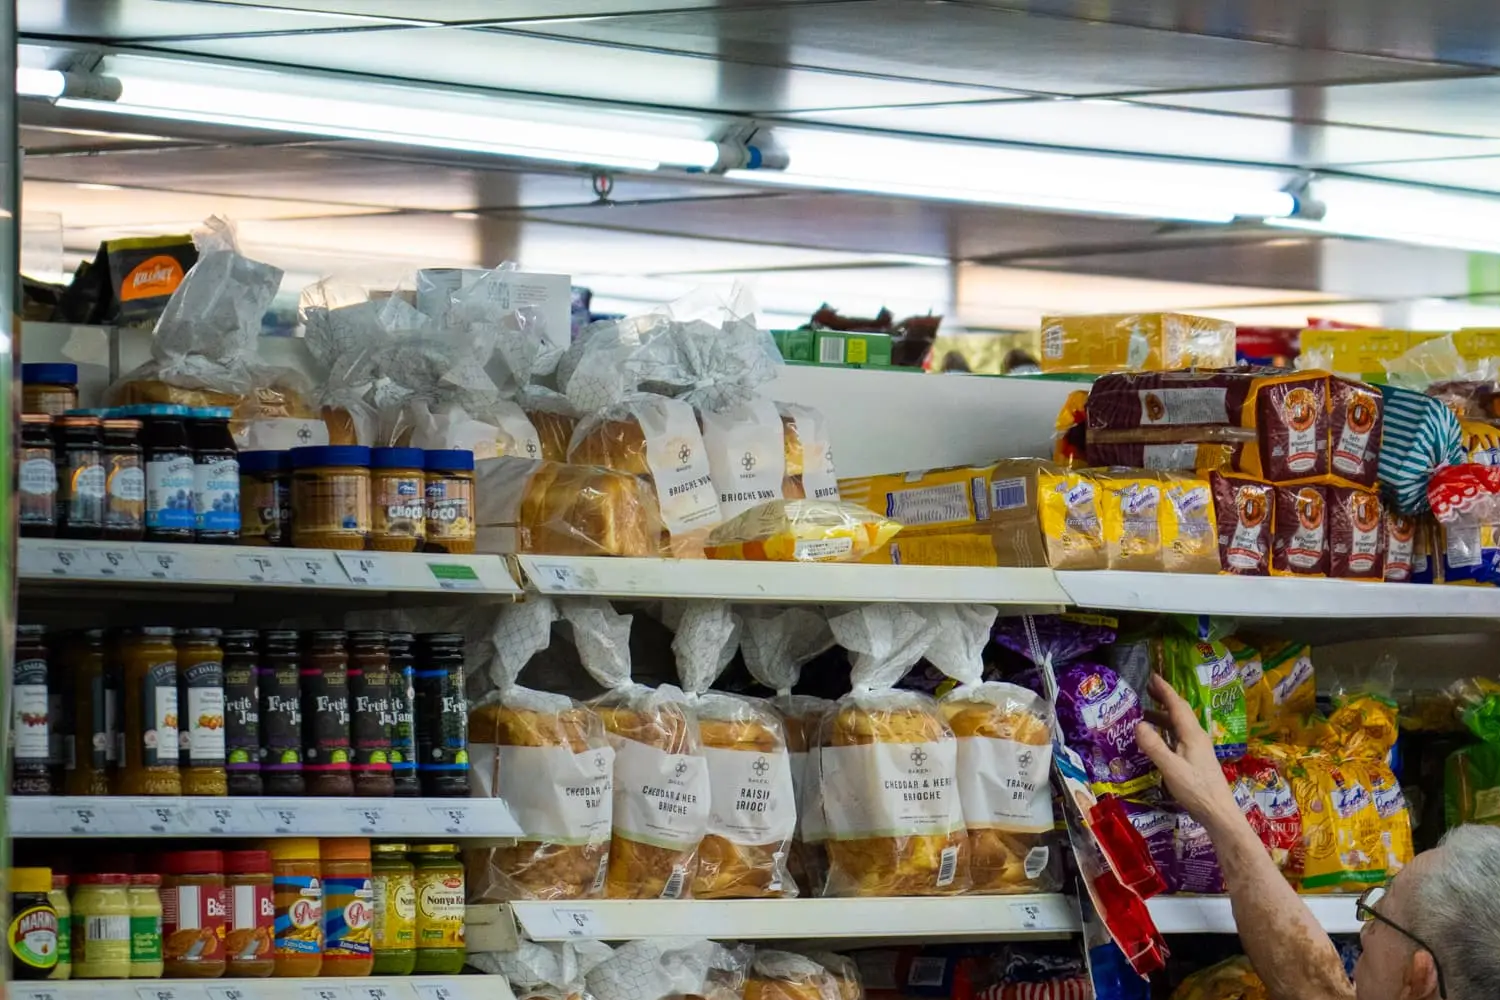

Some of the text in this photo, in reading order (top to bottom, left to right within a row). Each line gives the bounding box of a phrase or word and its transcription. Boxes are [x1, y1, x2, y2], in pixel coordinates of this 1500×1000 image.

[721, 490, 756, 503] BRIOCHE
[424, 506, 457, 520] HOCO
[442, 696, 466, 712] Fru
[884, 778, 920, 790] CHEDDAR
[922, 778, 931, 789] &
[642, 785, 674, 800] CHEDDAR
[903, 790, 942, 801] BRIOCHE
[657, 801, 688, 816] BRIOCHE
[20, 911, 58, 933] MARM
